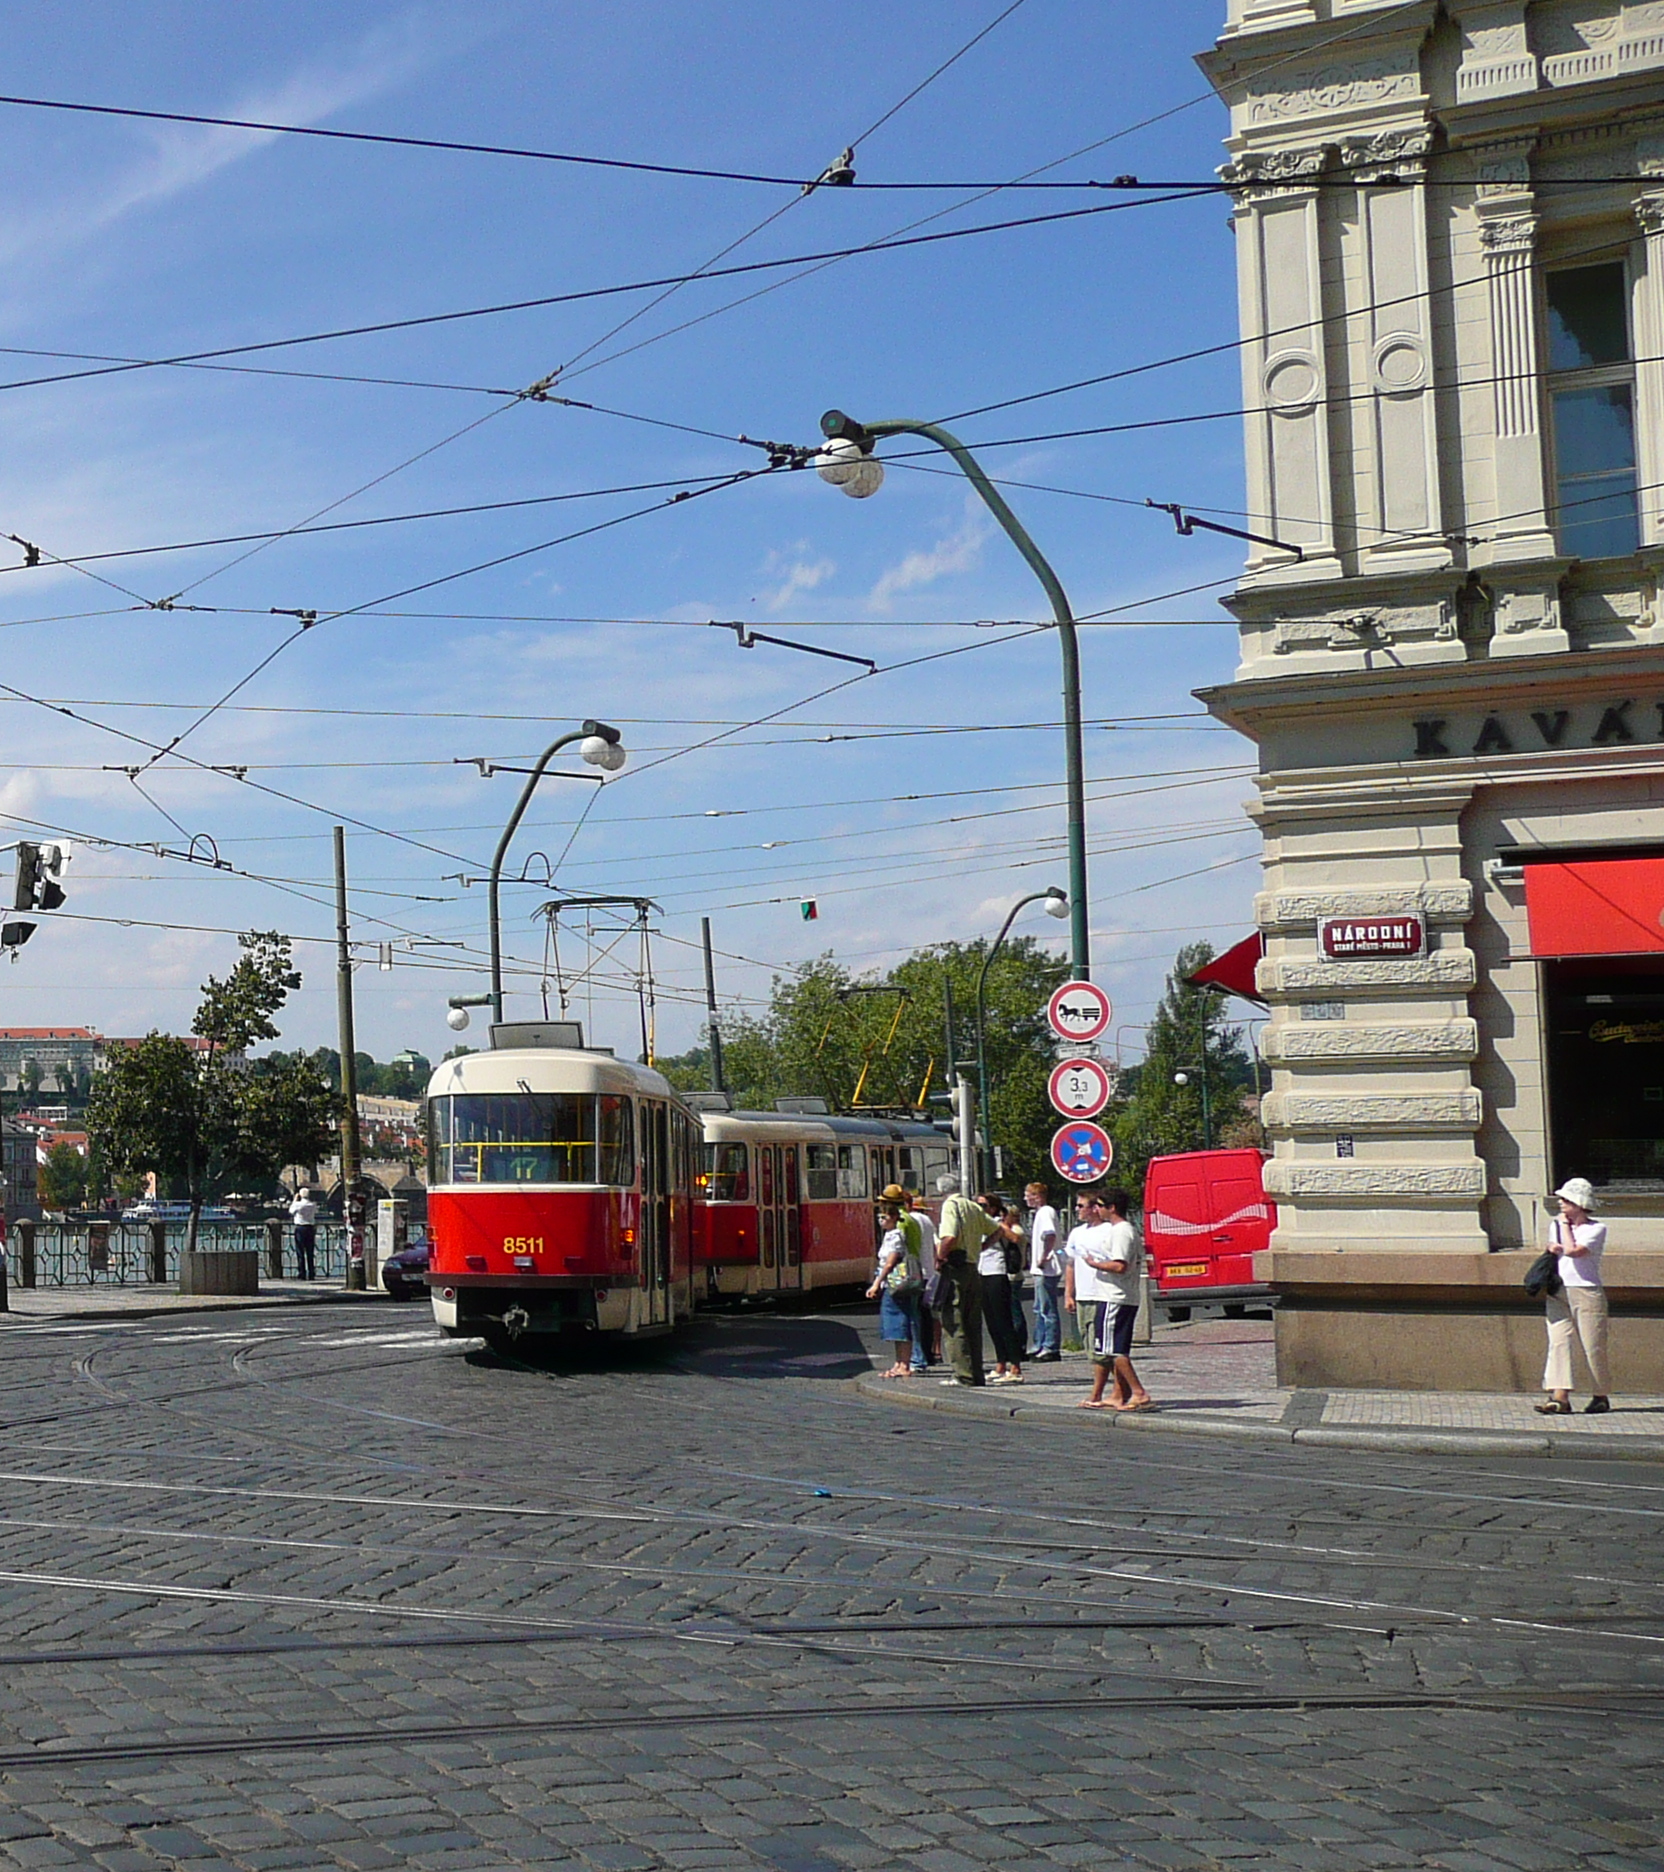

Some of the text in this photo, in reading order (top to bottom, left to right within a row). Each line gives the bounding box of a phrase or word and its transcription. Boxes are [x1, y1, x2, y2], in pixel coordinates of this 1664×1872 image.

[1412, 700, 1664, 755] KAVÁ
[1331, 921, 1413, 942] NÁRODNÍ
[1069, 1077, 1088, 1092] 3.3
[511, 1157, 538, 1179] 17
[503, 1237, 544, 1254] 8511
